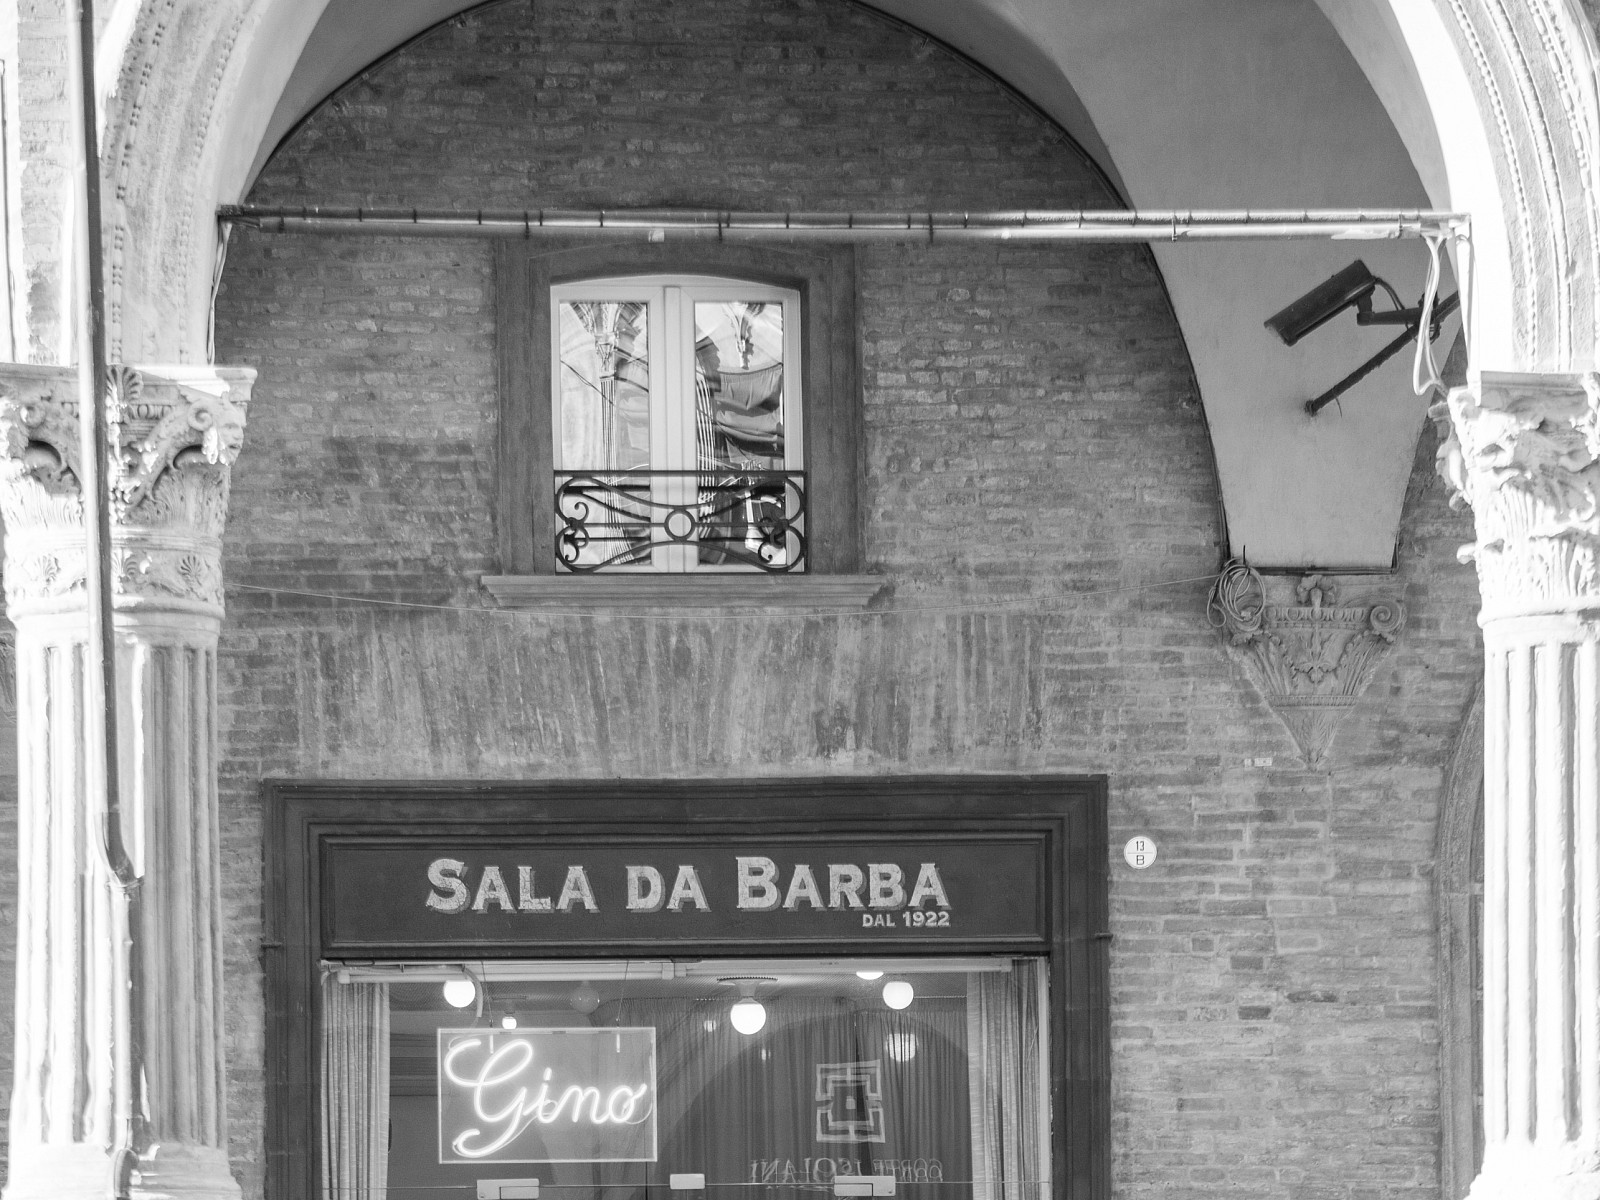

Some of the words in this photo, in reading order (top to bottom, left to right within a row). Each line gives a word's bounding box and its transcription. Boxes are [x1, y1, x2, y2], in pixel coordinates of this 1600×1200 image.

[1136, 840, 1145, 852] 13
[1136, 855, 1145, 865] B
[426, 858, 599, 913] SALA
[626, 865, 710, 912] DA
[735, 856, 951, 911] BARBA
[862, 913, 896, 928] DAL
[902, 911, 951, 928] 1922
[444, 1038, 648, 1158] Gino
